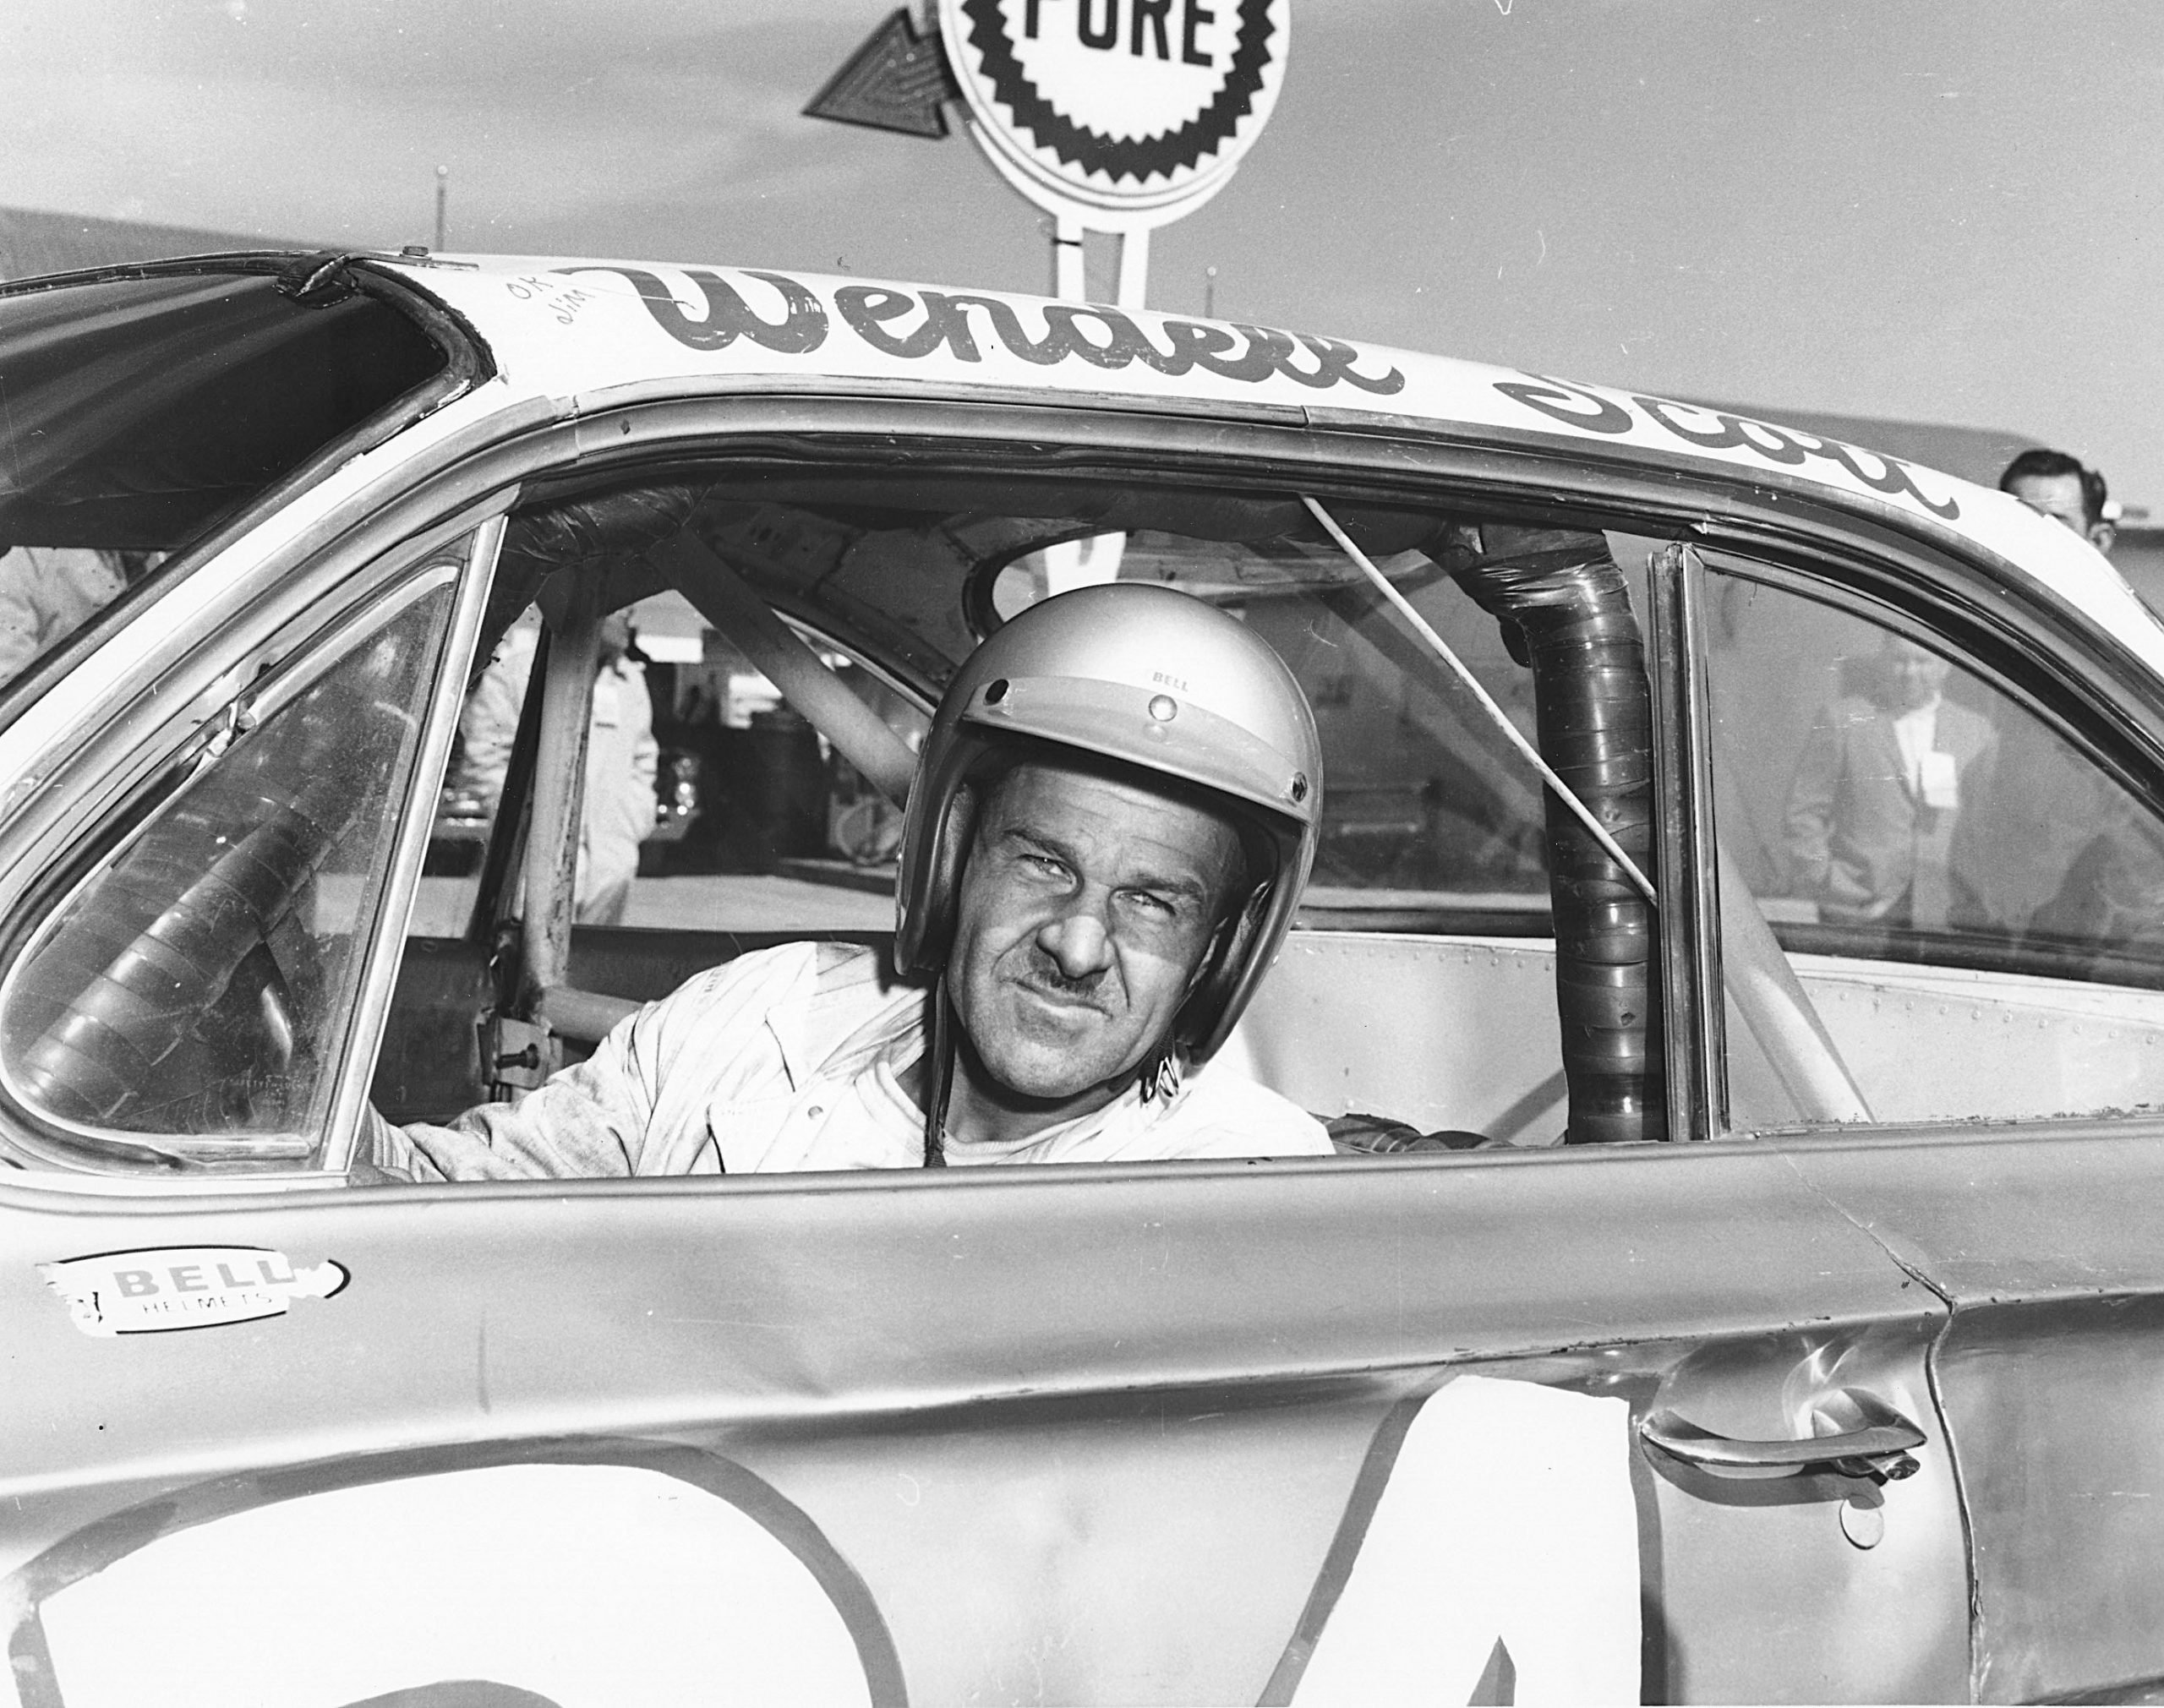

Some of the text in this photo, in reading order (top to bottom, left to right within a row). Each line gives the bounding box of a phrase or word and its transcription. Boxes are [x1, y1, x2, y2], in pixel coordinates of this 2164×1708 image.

[506, 276, 554, 299] OK
[547, 266, 1405, 396] Wendell
[1152, 671, 1189, 692] BELL
[112, 1259, 297, 1298] BELL
